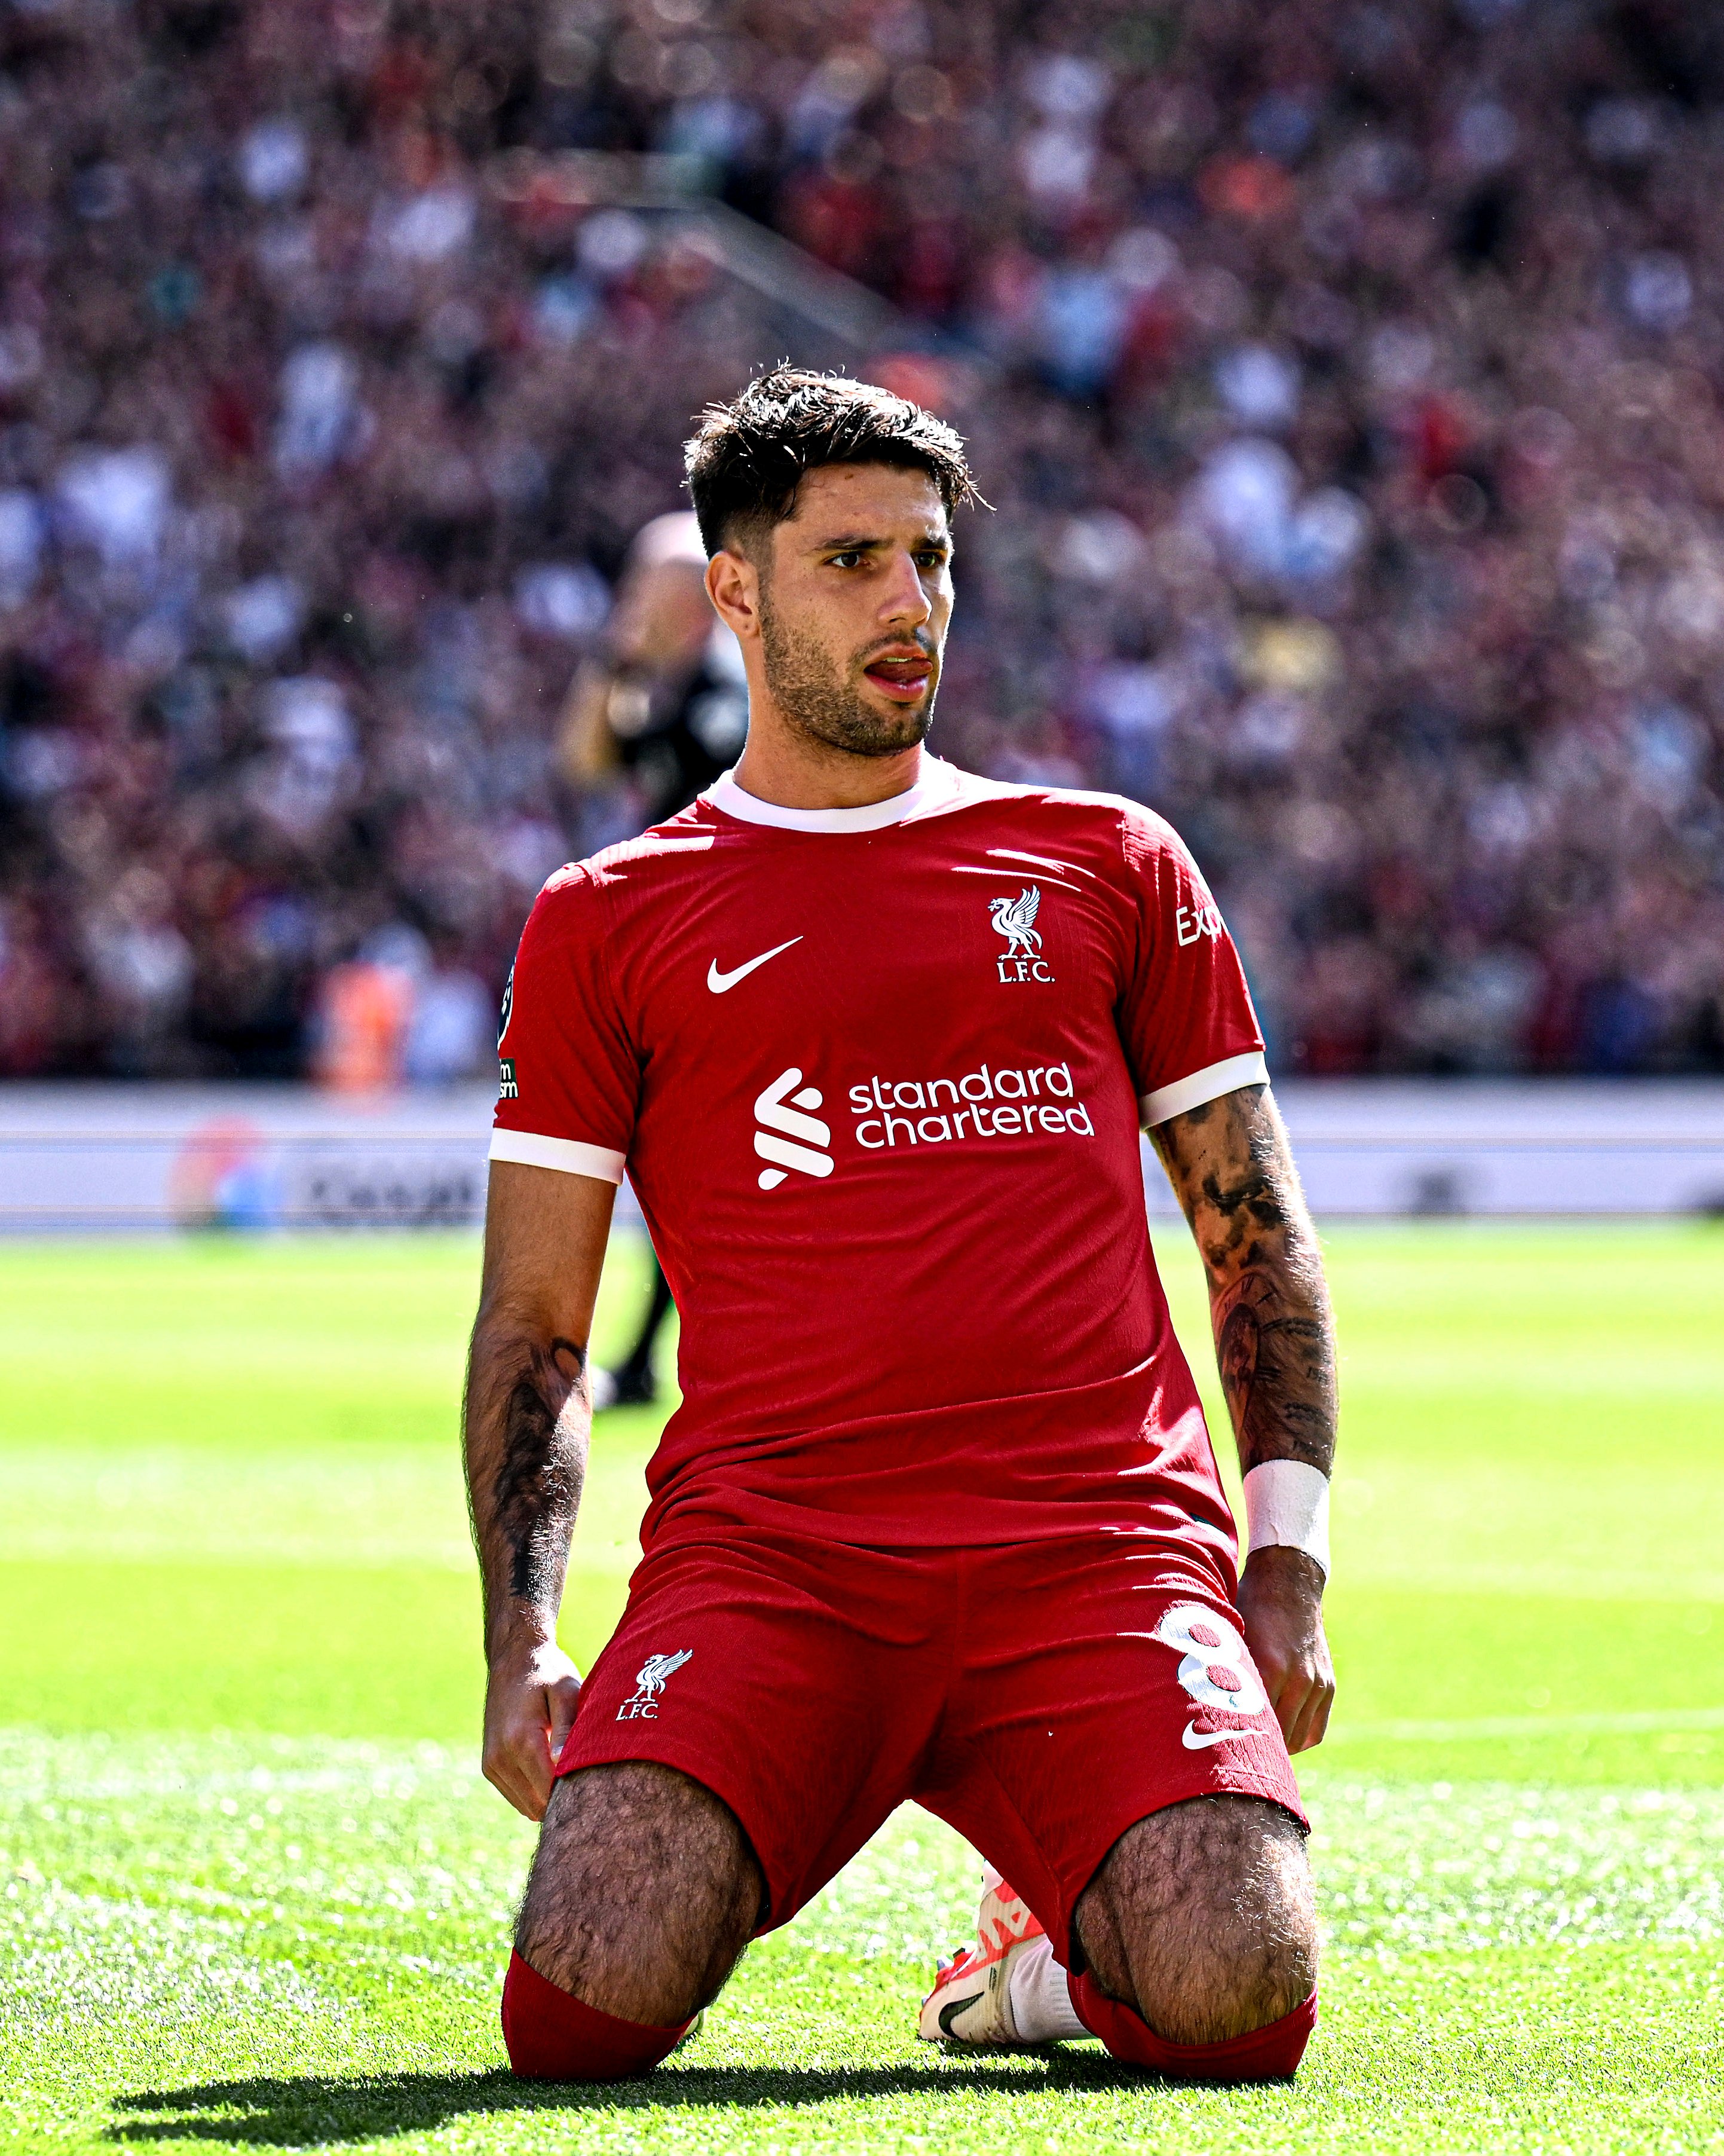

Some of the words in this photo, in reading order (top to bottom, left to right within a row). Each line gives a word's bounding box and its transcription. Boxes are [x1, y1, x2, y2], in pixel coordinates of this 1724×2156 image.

[996, 961, 1055, 983] L.F.C.
[849, 1062, 1073, 1114] standard
[856, 1102, 1095, 1149] chartered
[1159, 1605, 1265, 1714] 8
[615, 1704, 659, 1721] L.F.C.
